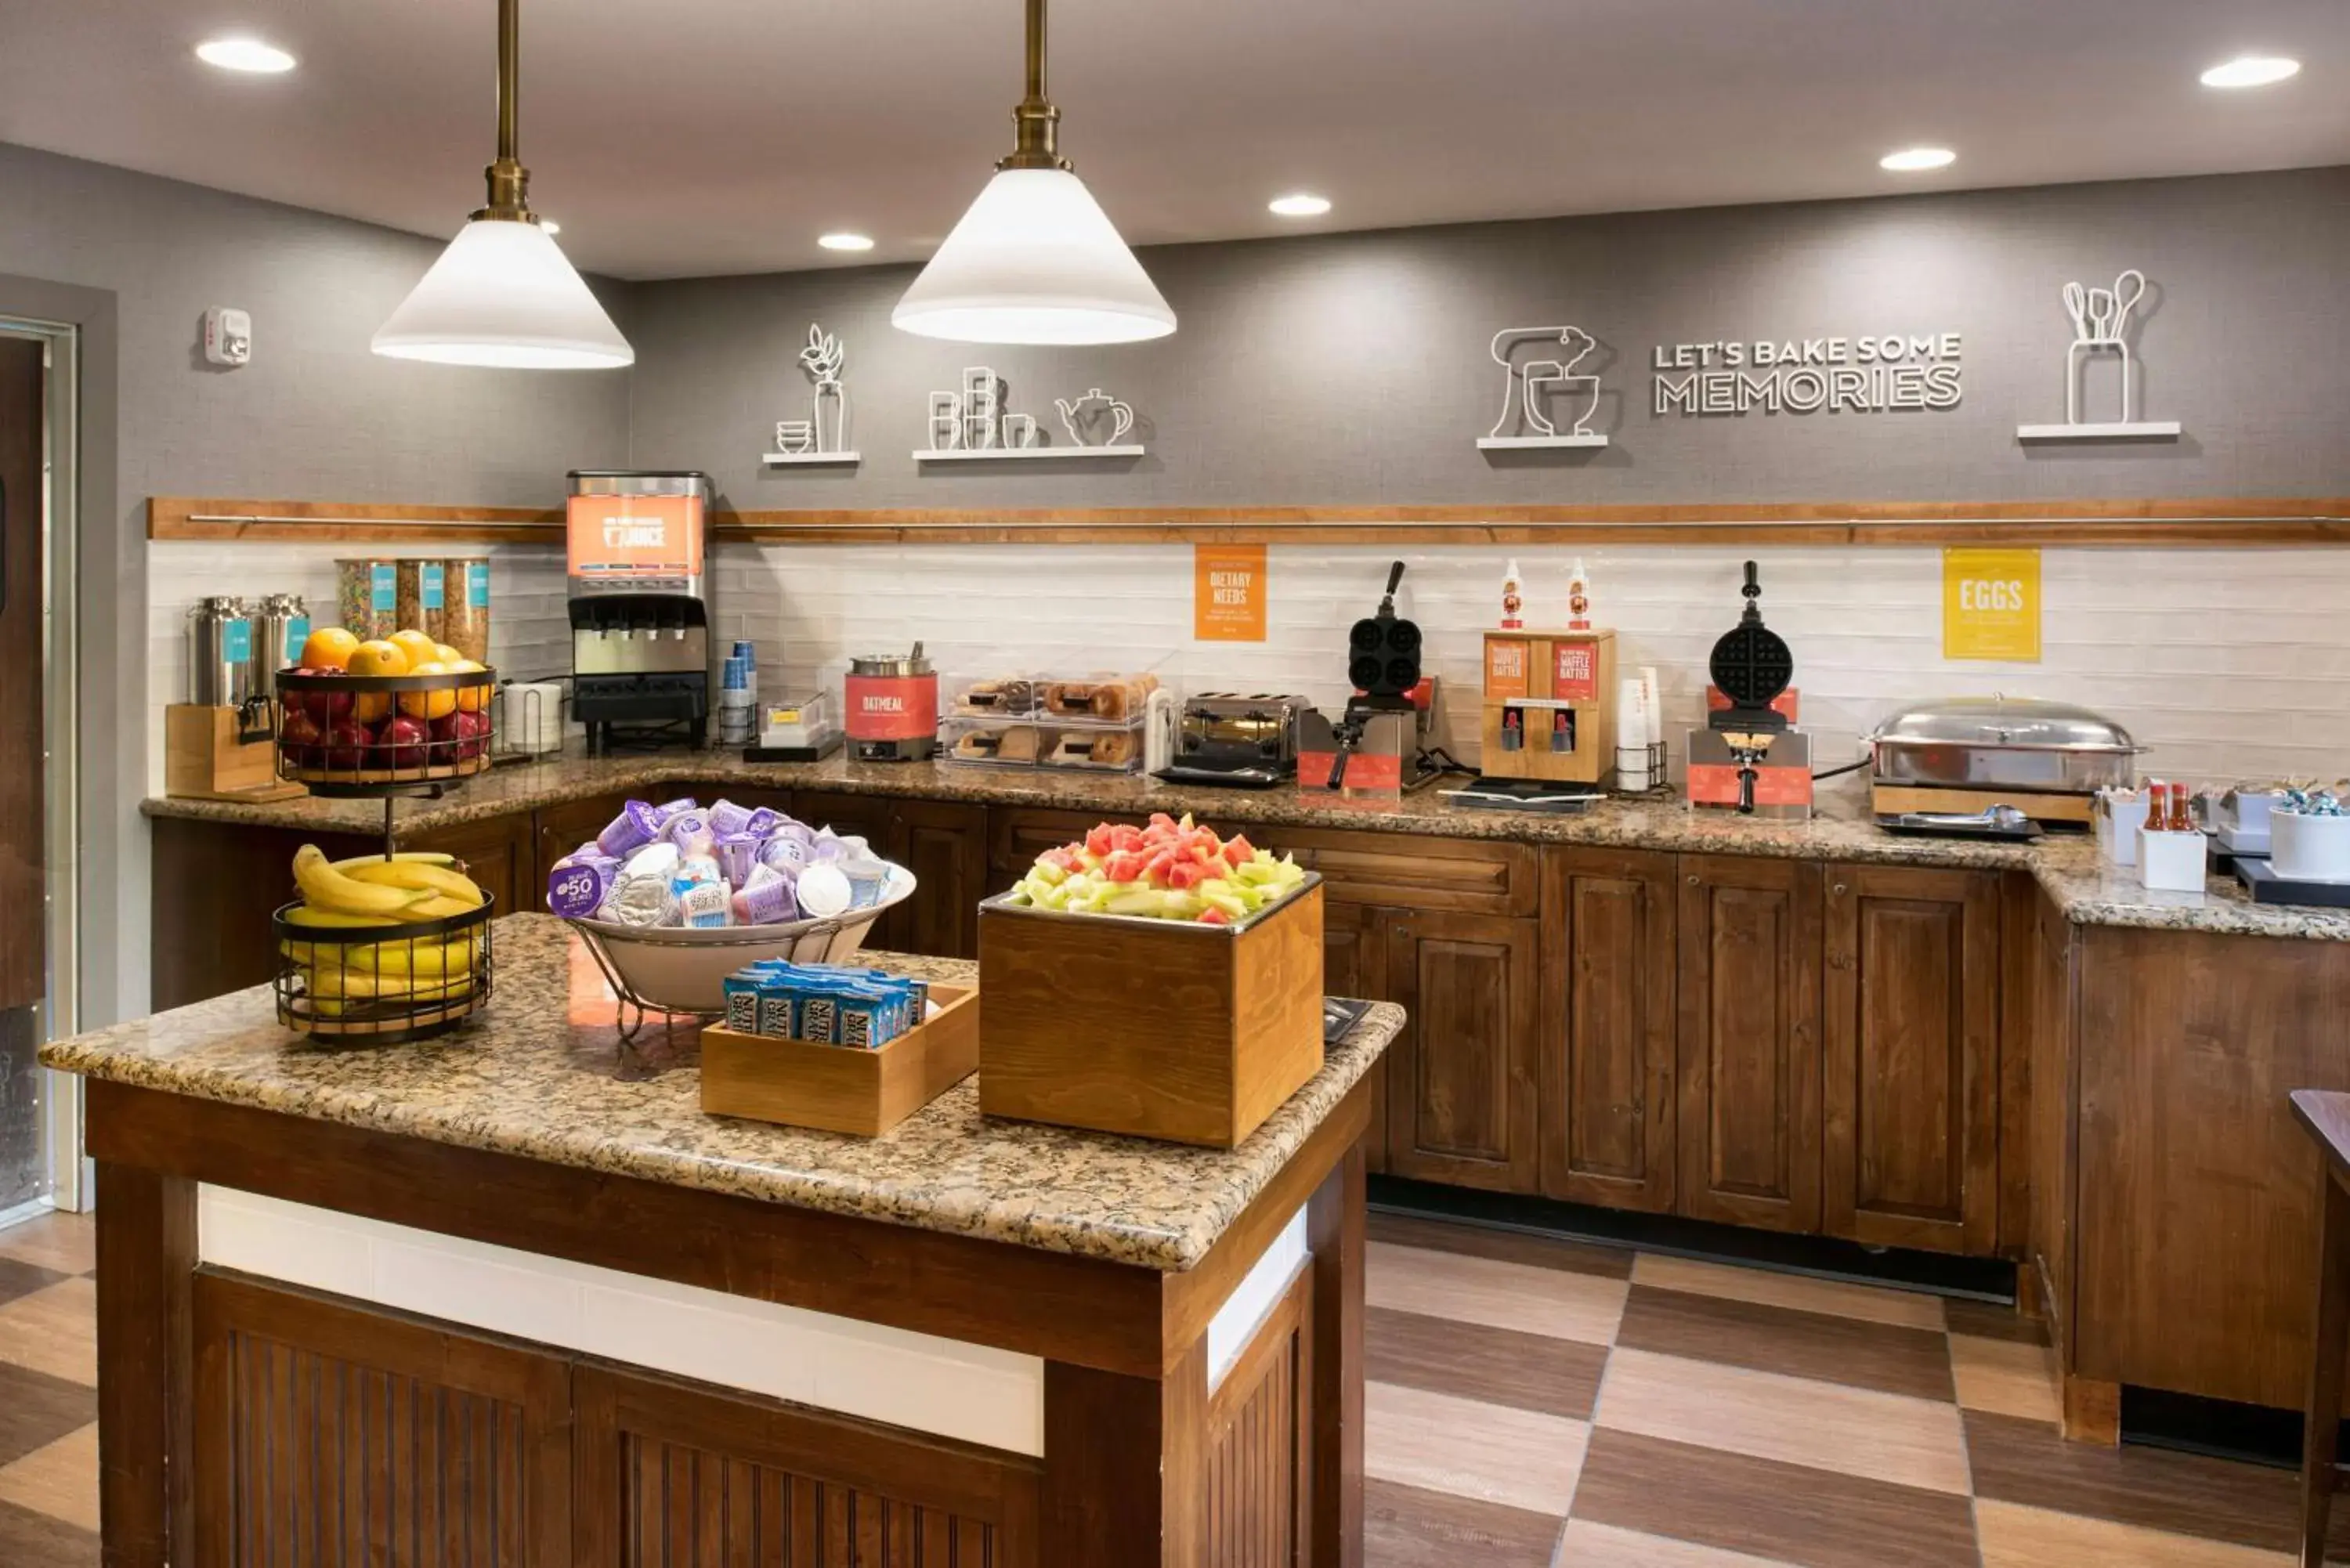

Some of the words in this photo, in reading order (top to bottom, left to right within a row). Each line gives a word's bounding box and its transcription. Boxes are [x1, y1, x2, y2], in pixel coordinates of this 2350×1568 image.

[1654, 341, 1744, 368] LET'S
[1754, 337, 1848, 365] BAKE
[1856, 333, 1962, 362] SOME
[1654, 364, 1962, 414] MEMORIES
[1209, 572, 1251, 588] DIETARY
[1213, 587, 1247, 605] NEEDS
[1960, 579, 2023, 611] EGGS
[1560, 656, 1590, 668] WAFFLE
[1560, 667, 1590, 680] BATTER
[862, 695, 902, 712] OATMEAL
[568, 878, 593, 896] 50
